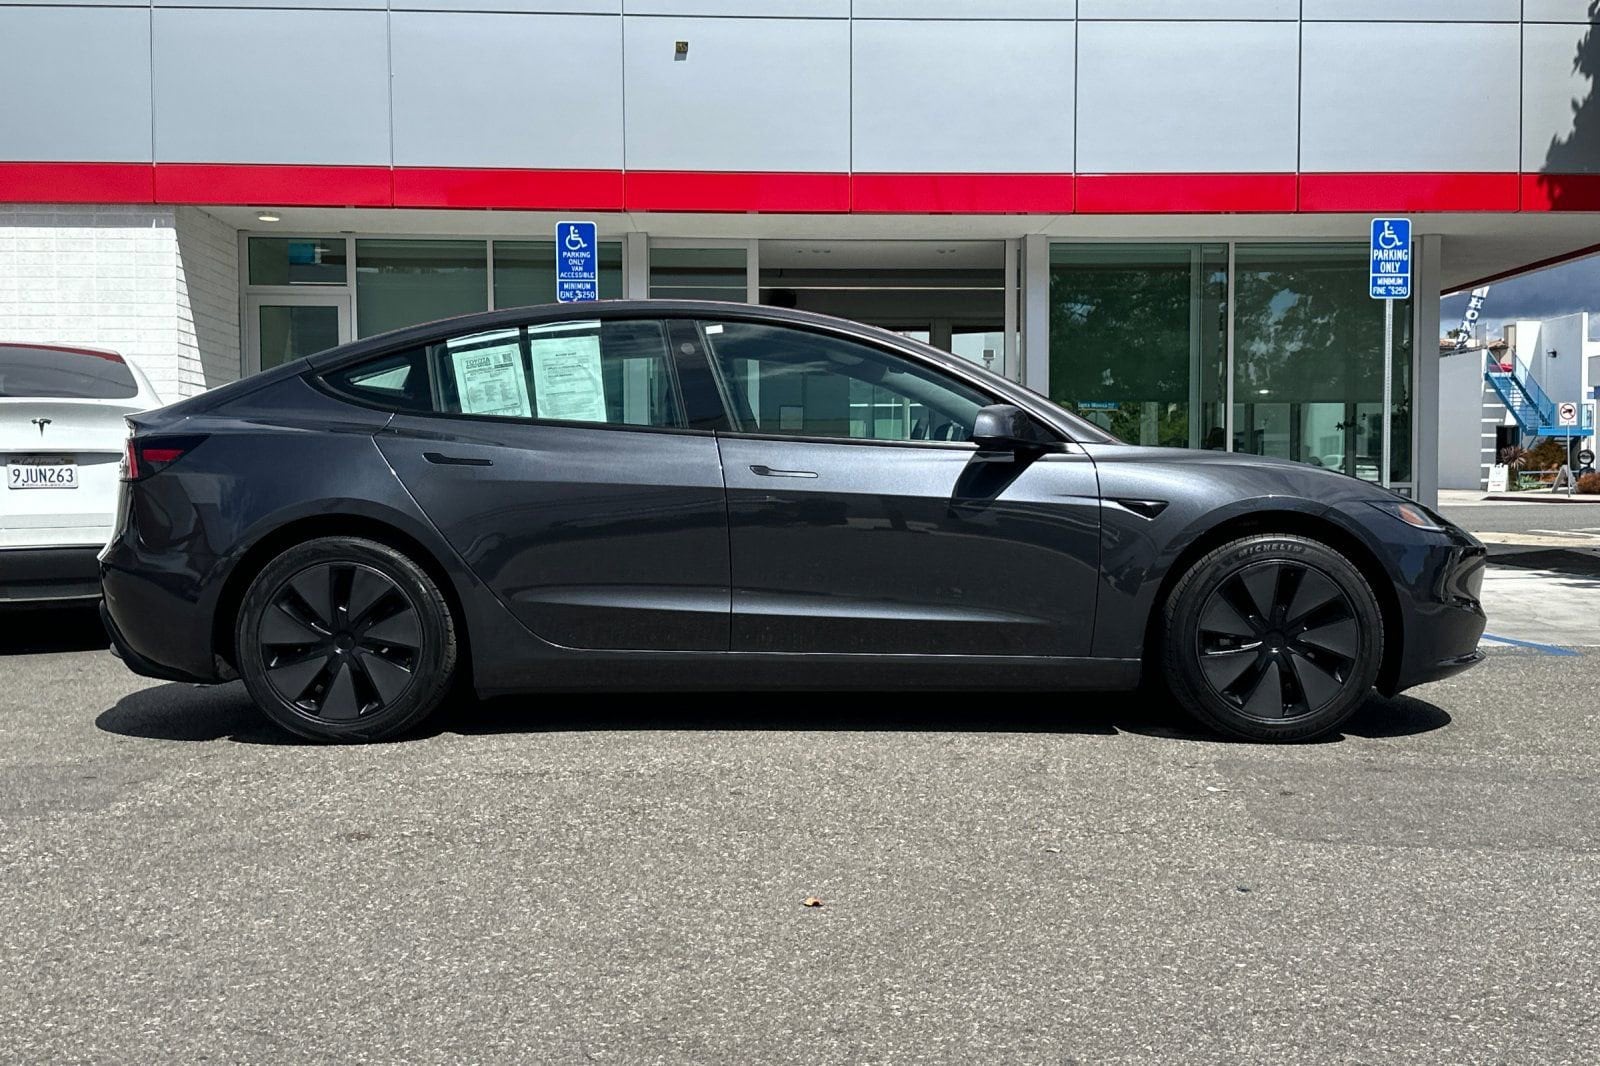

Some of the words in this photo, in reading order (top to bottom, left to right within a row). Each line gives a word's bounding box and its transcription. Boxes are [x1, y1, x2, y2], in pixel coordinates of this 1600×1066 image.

[1373, 249, 1408, 261] PARKING
[568, 258, 585, 266] ONLY
[1379, 261, 1401, 273] ONLY
[559, 271, 595, 279] ACCESSIBLE
[1376, 277, 1404, 285] MINIMUM
[563, 282, 591, 290] MINIMUM
[1372, 286, 1386, 295] FINE
[12, 468, 74, 483] 9JUN263
[1238, 543, 1304, 558] MICHELIN
